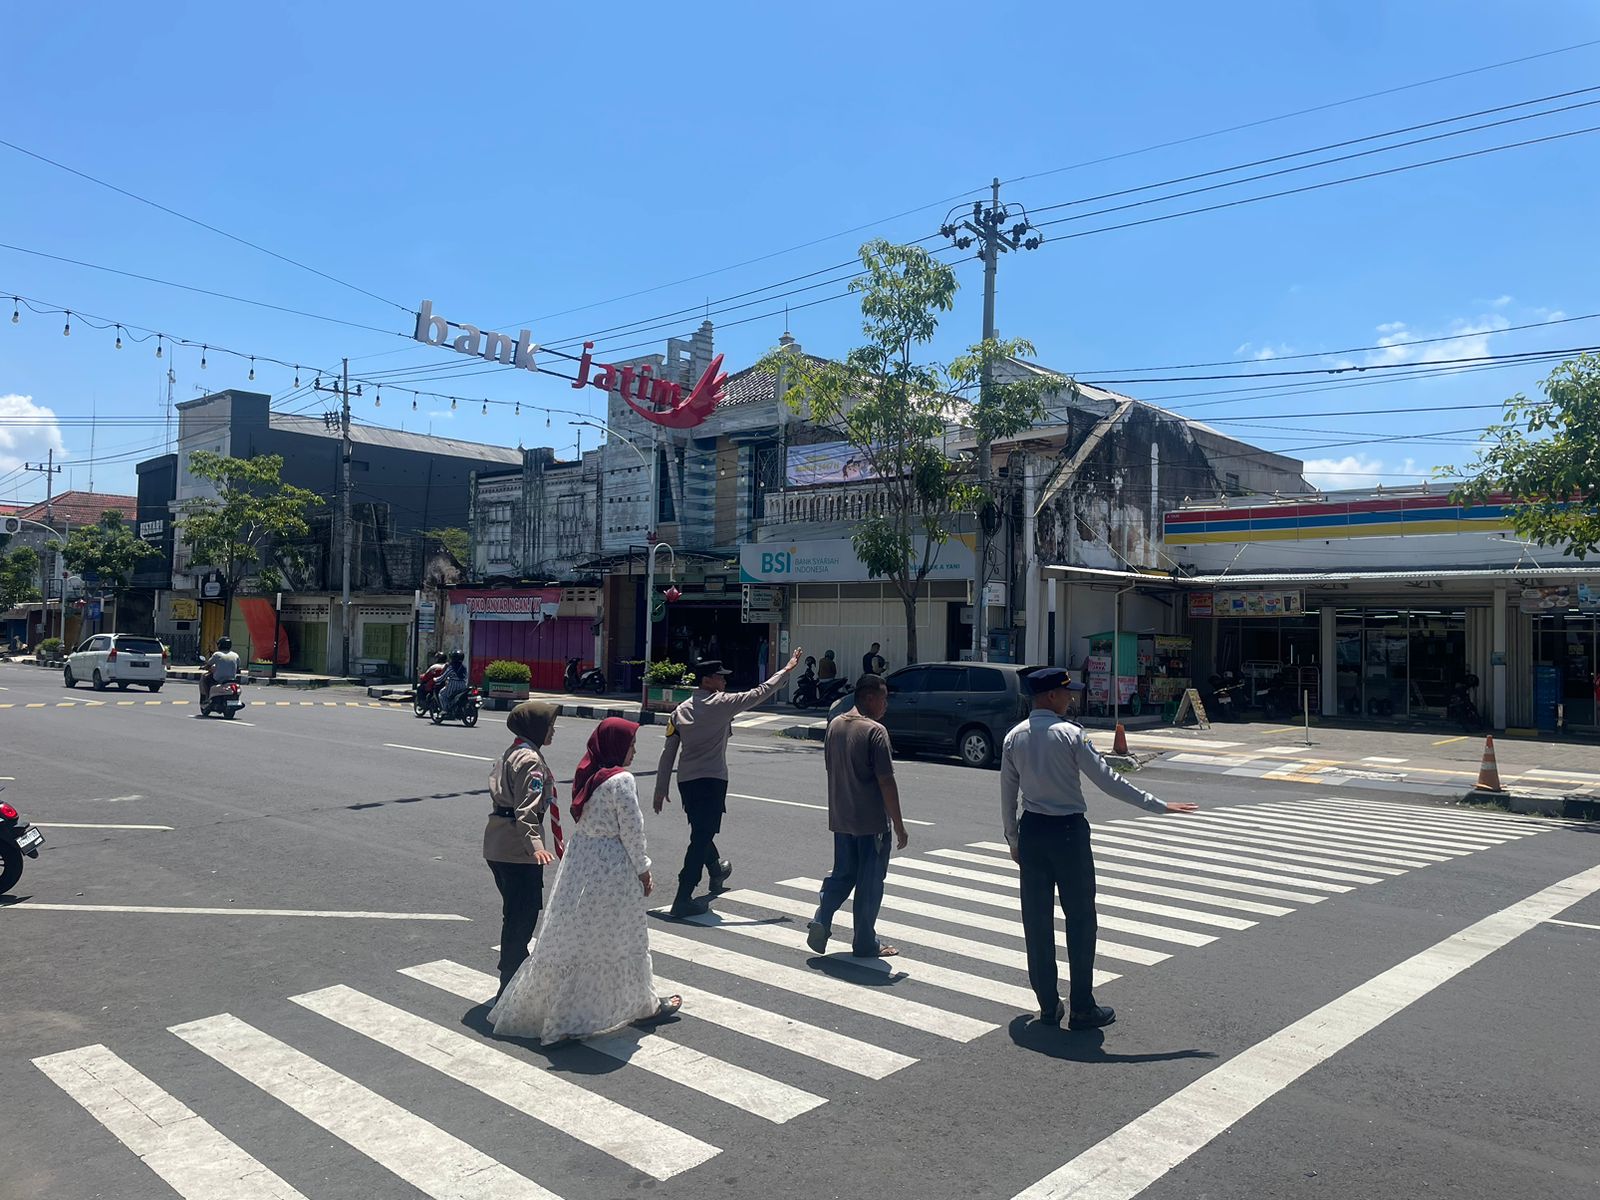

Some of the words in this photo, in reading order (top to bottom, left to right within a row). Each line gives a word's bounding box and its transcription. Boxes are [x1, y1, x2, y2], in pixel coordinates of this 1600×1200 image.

[416, 299, 540, 372] bank
[571, 341, 682, 409] jatim
[761, 552, 791, 573] BSI
[813, 557, 839, 565] SYARIAH
[466, 597, 485, 612] TOKO
[486, 597, 509, 612] ANYAR
